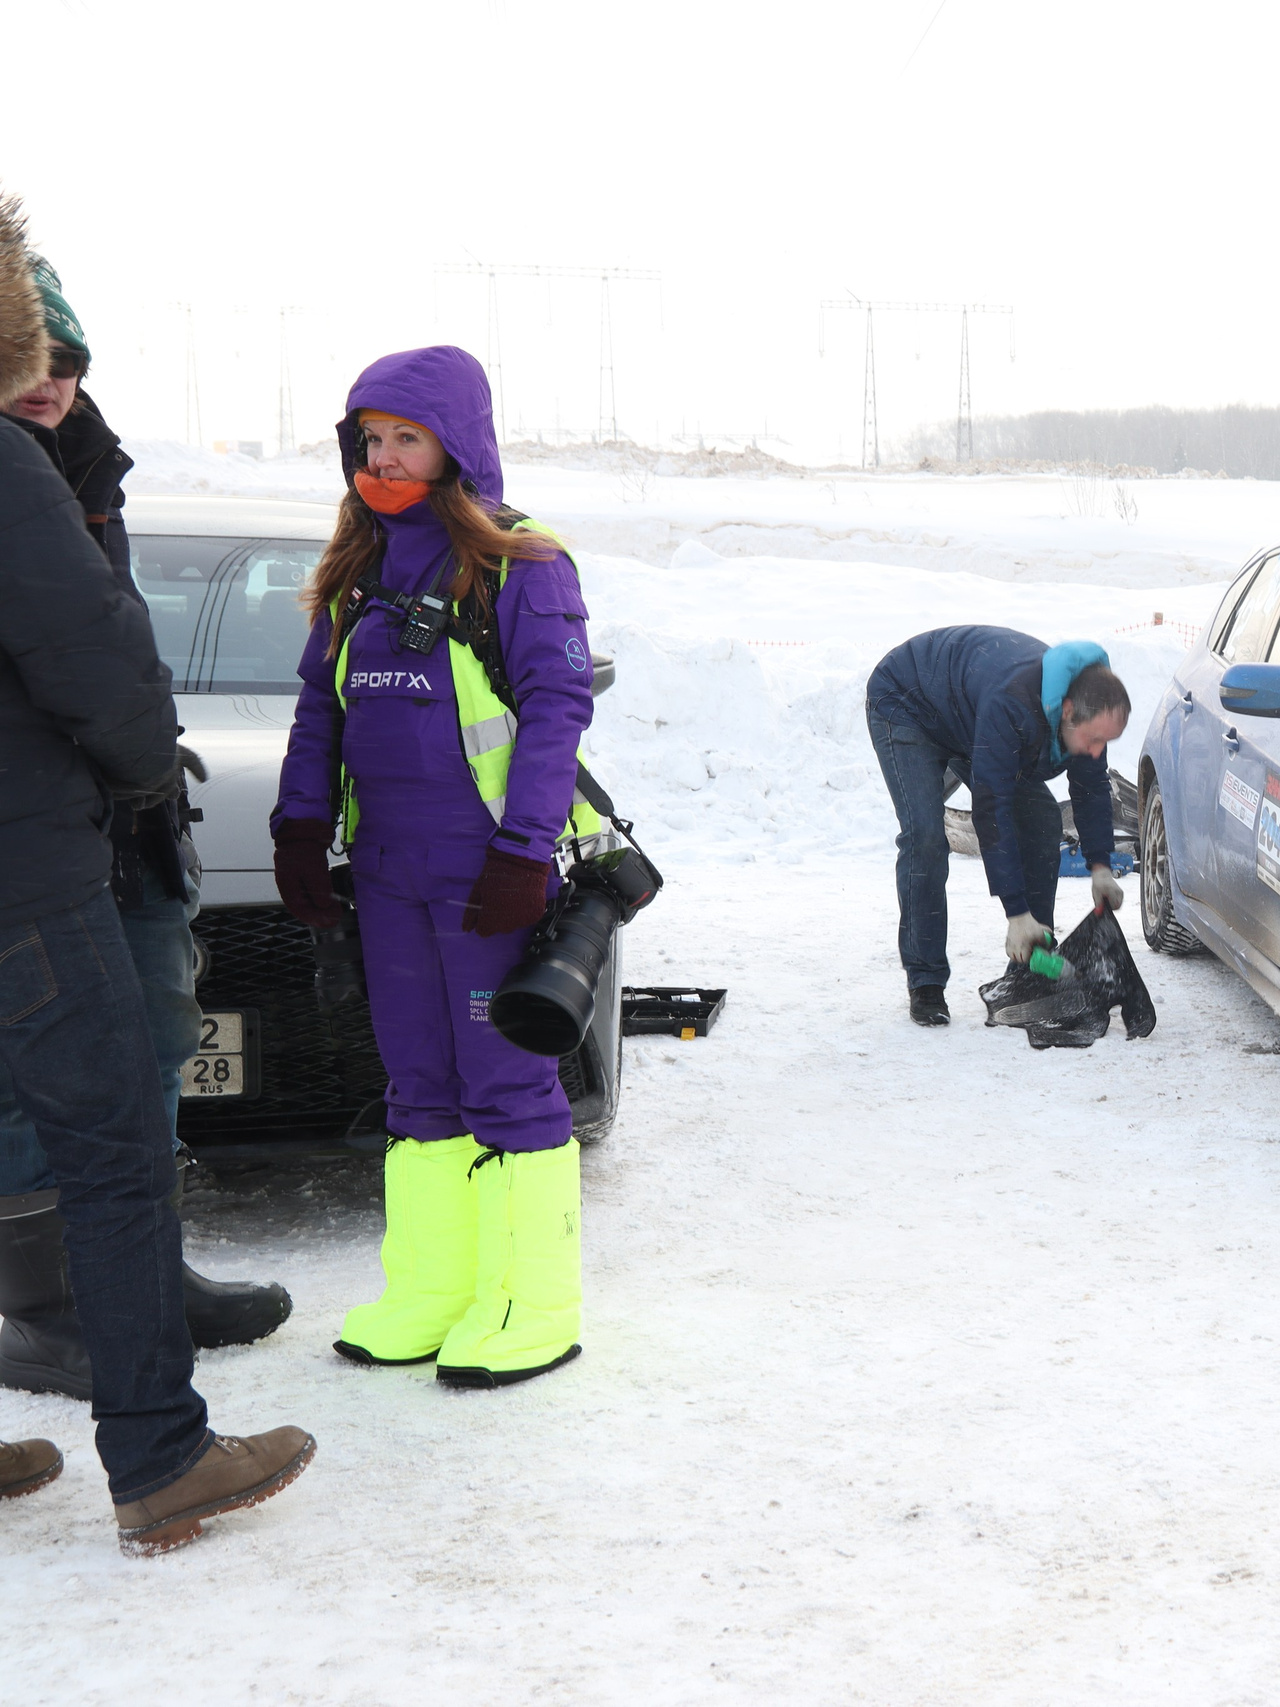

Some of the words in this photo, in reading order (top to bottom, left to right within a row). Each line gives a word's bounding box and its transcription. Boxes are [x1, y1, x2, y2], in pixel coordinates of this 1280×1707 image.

[470, 990, 497, 999] SPO
[193, 1058, 230, 1083] 28
[200, 1085, 224, 1094] RUS
